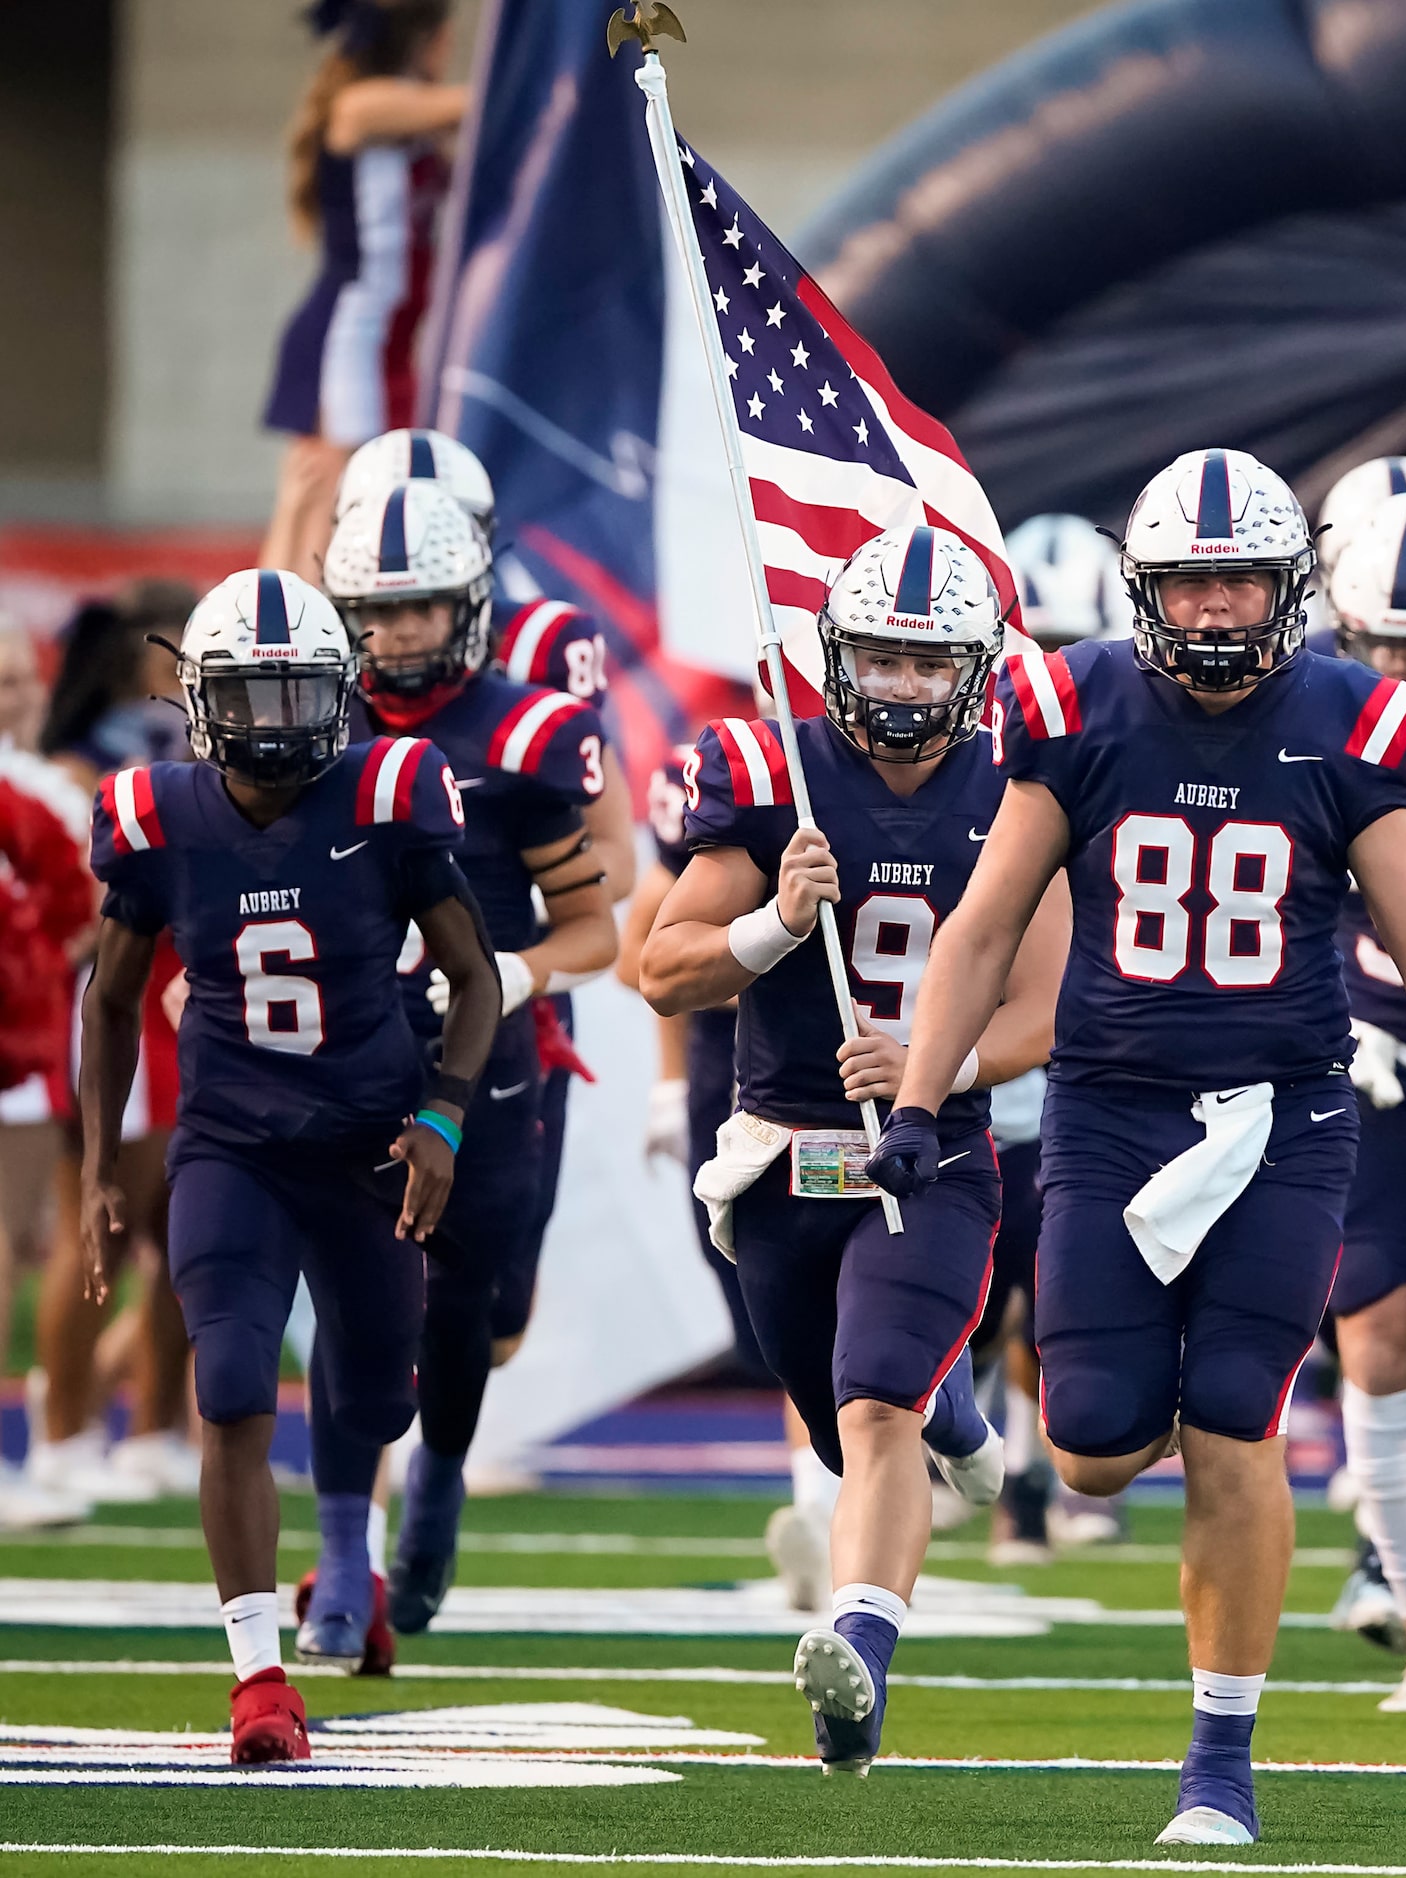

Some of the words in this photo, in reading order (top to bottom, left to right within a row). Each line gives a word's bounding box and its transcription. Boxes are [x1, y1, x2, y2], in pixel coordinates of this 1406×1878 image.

[886, 616, 934, 631] Riddell
[252, 648, 299, 658] Riddell
[886, 731, 914, 739] Riddell
[1174, 782, 1241, 810] AUBREY
[869, 862, 935, 887] AUBREY
[239, 888, 301, 914] AUBREY
[1111, 811, 1295, 989] 88
[850, 891, 939, 1047] 9
[232, 917, 327, 1056] 6
